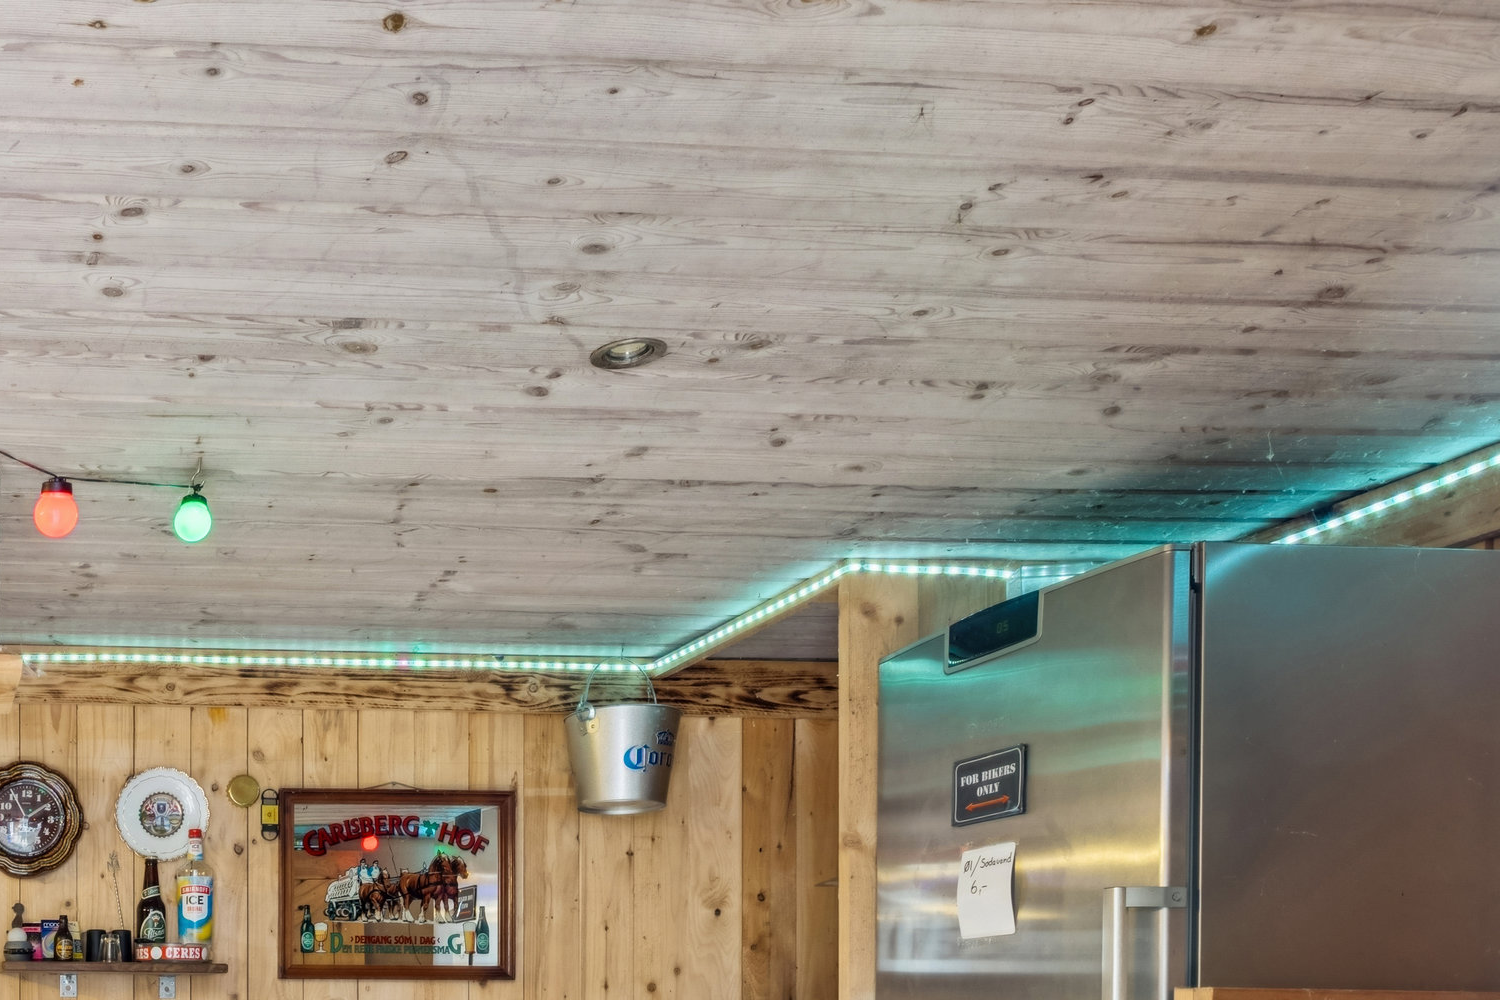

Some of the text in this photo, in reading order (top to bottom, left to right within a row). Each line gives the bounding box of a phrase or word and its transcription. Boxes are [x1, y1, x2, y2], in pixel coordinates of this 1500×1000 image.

[623, 744, 673, 772] Coro
[960, 763, 1016, 787] FOR BIKERS
[21, 789, 33, 798] 12
[976, 782, 1000, 797] ONLY
[0, 802, 12, 810] 10
[303, 814, 490, 857] CARLSBERG HOF
[181, 885, 208, 894] SMIRNOFF
[185, 895, 204, 905] ICE
[355, 935, 392, 944] DENGANG
[393, 935, 413, 944] SOM
[420, 935, 436, 944] DAG
[165, 946, 201, 959] CERES
